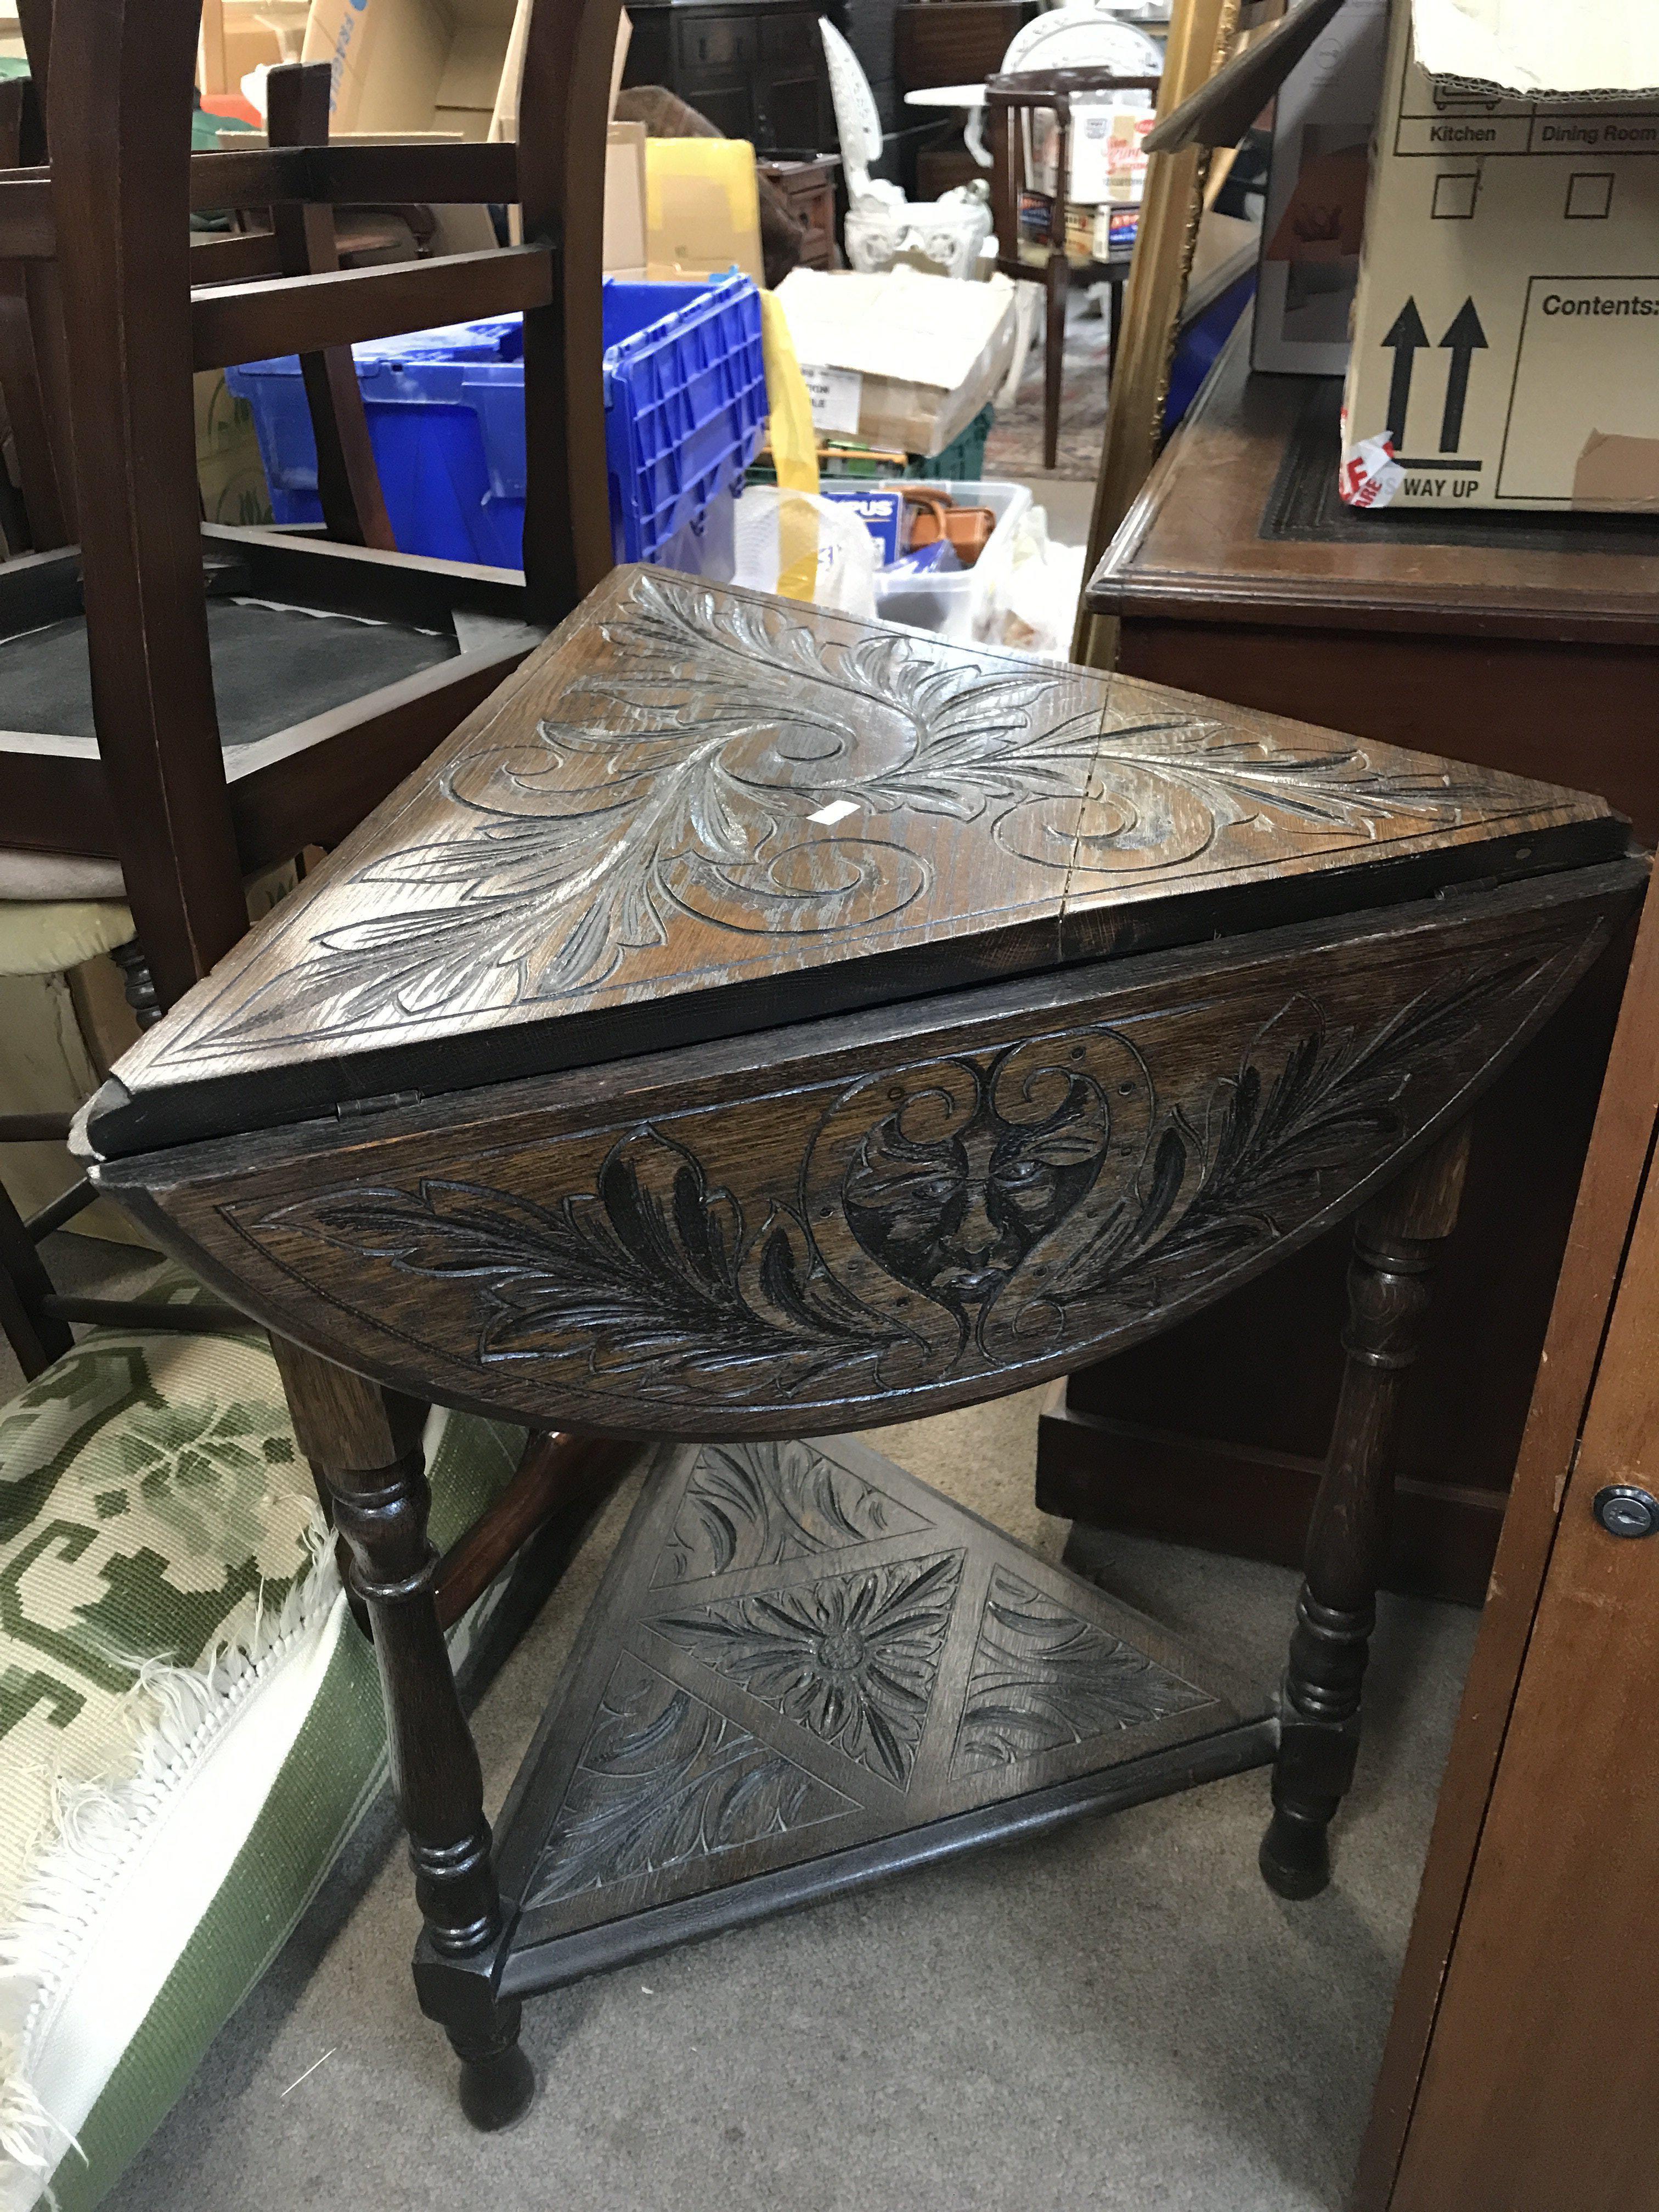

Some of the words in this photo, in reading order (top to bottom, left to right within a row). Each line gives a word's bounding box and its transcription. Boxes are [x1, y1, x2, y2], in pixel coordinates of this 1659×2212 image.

[1430, 126, 1497, 142] Kitchen
[1542, 125, 1598, 145] Dining
[1603, 125, 1657, 142] Room
[1403, 478, 1447, 496] WAY
[1452, 480, 1479, 498] UP
